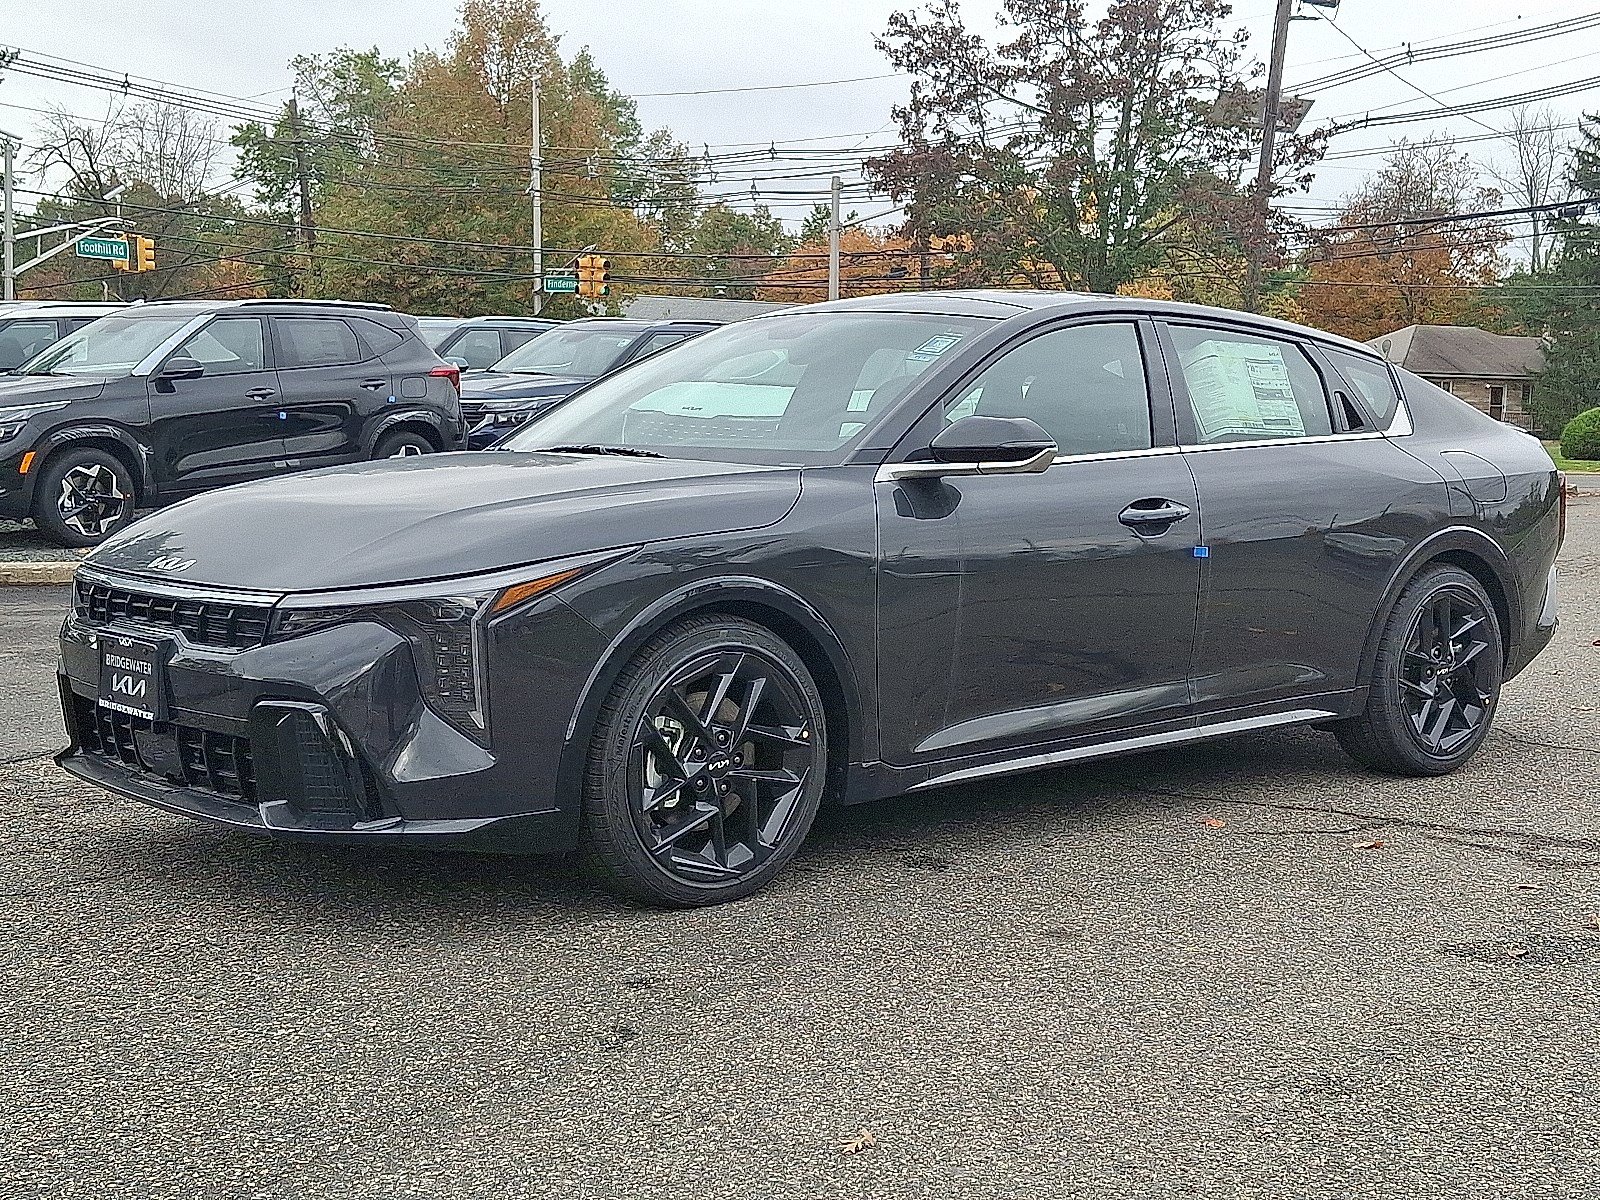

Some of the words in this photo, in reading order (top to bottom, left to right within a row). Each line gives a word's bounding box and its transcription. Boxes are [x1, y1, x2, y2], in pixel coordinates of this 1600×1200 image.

[80, 241, 111, 254] Foothill
[112, 244, 125, 257] Rd
[105, 653, 152, 675] BRIDGEWATER
[113, 673, 146, 698] KIA
[98, 697, 155, 720] BRIDGEWATER
